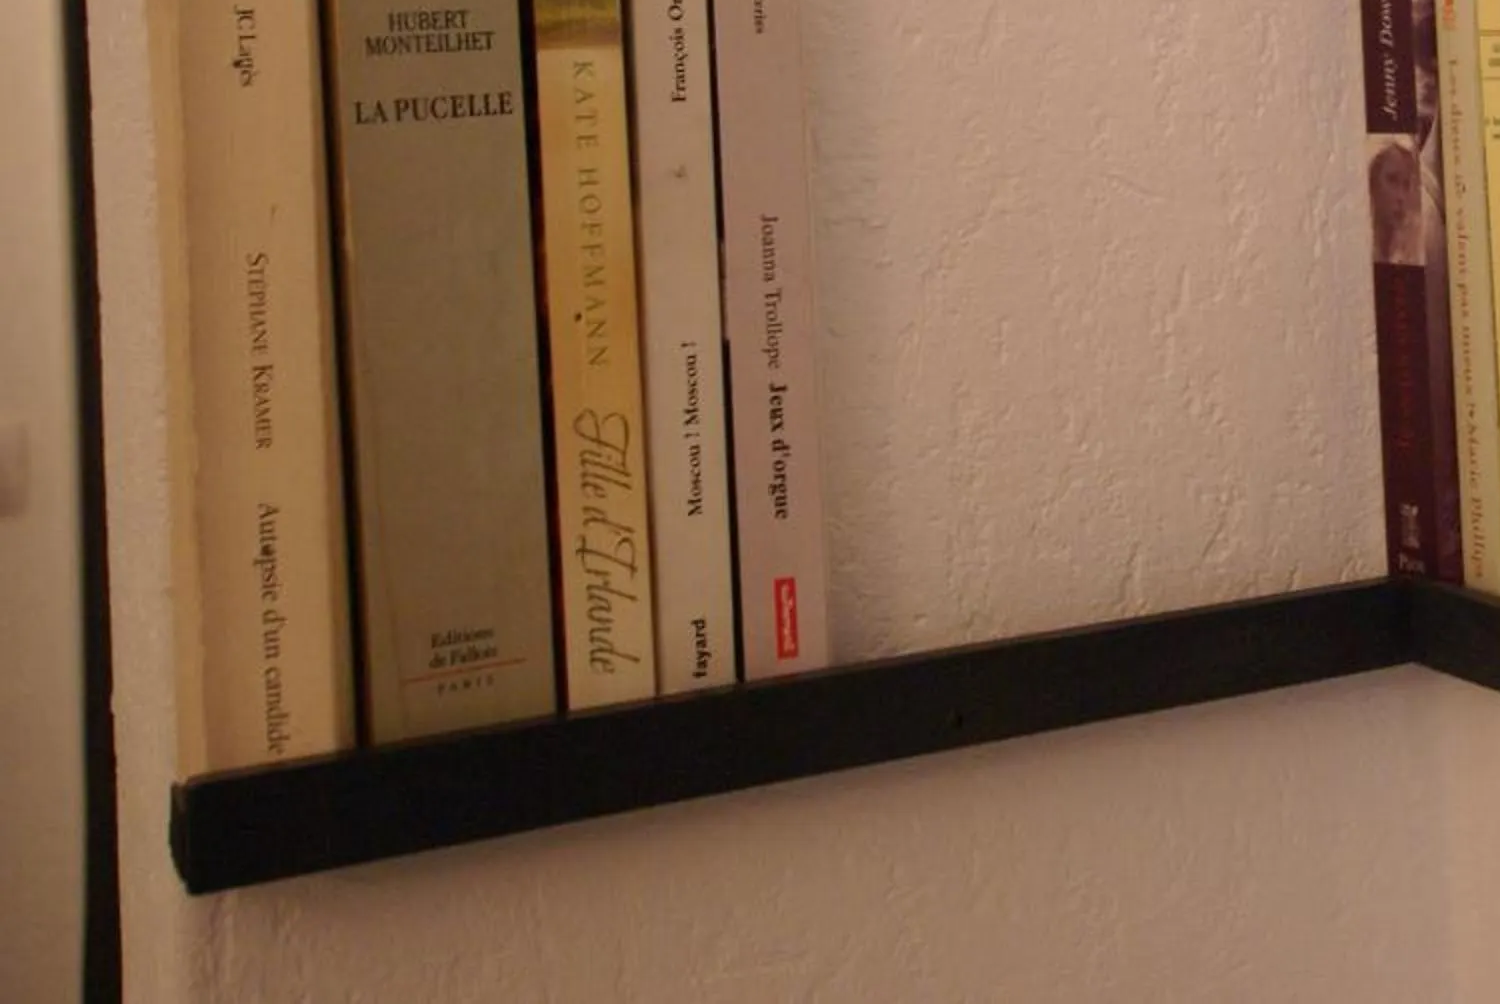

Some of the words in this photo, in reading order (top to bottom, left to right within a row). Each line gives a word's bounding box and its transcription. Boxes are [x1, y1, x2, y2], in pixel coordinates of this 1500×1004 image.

[364, 30, 496, 56] MONTEILHET
[387, 9, 470, 32] HUBERT
[668, 27, 688, 103] François
[1379, 54, 1399, 121] Jenny
[353, 99, 389, 125] LA
[393, 92, 514, 123] PUCELLE
[573, 60, 600, 151] KATE
[577, 167, 608, 367] HOFFMANN
[760, 213, 780, 283] Joanna
[762, 288, 783, 370] Trollope
[683, 353, 700, 427] Moscou
[769, 382, 789, 433] Jeux
[687, 444, 704, 517] Moscou
[769, 438, 792, 521] d'orgue
[253, 503, 285, 601] Autopsie
[262, 609, 288, 661] d'un
[691, 618, 712, 679] fayard
[265, 665, 291, 756] candide
